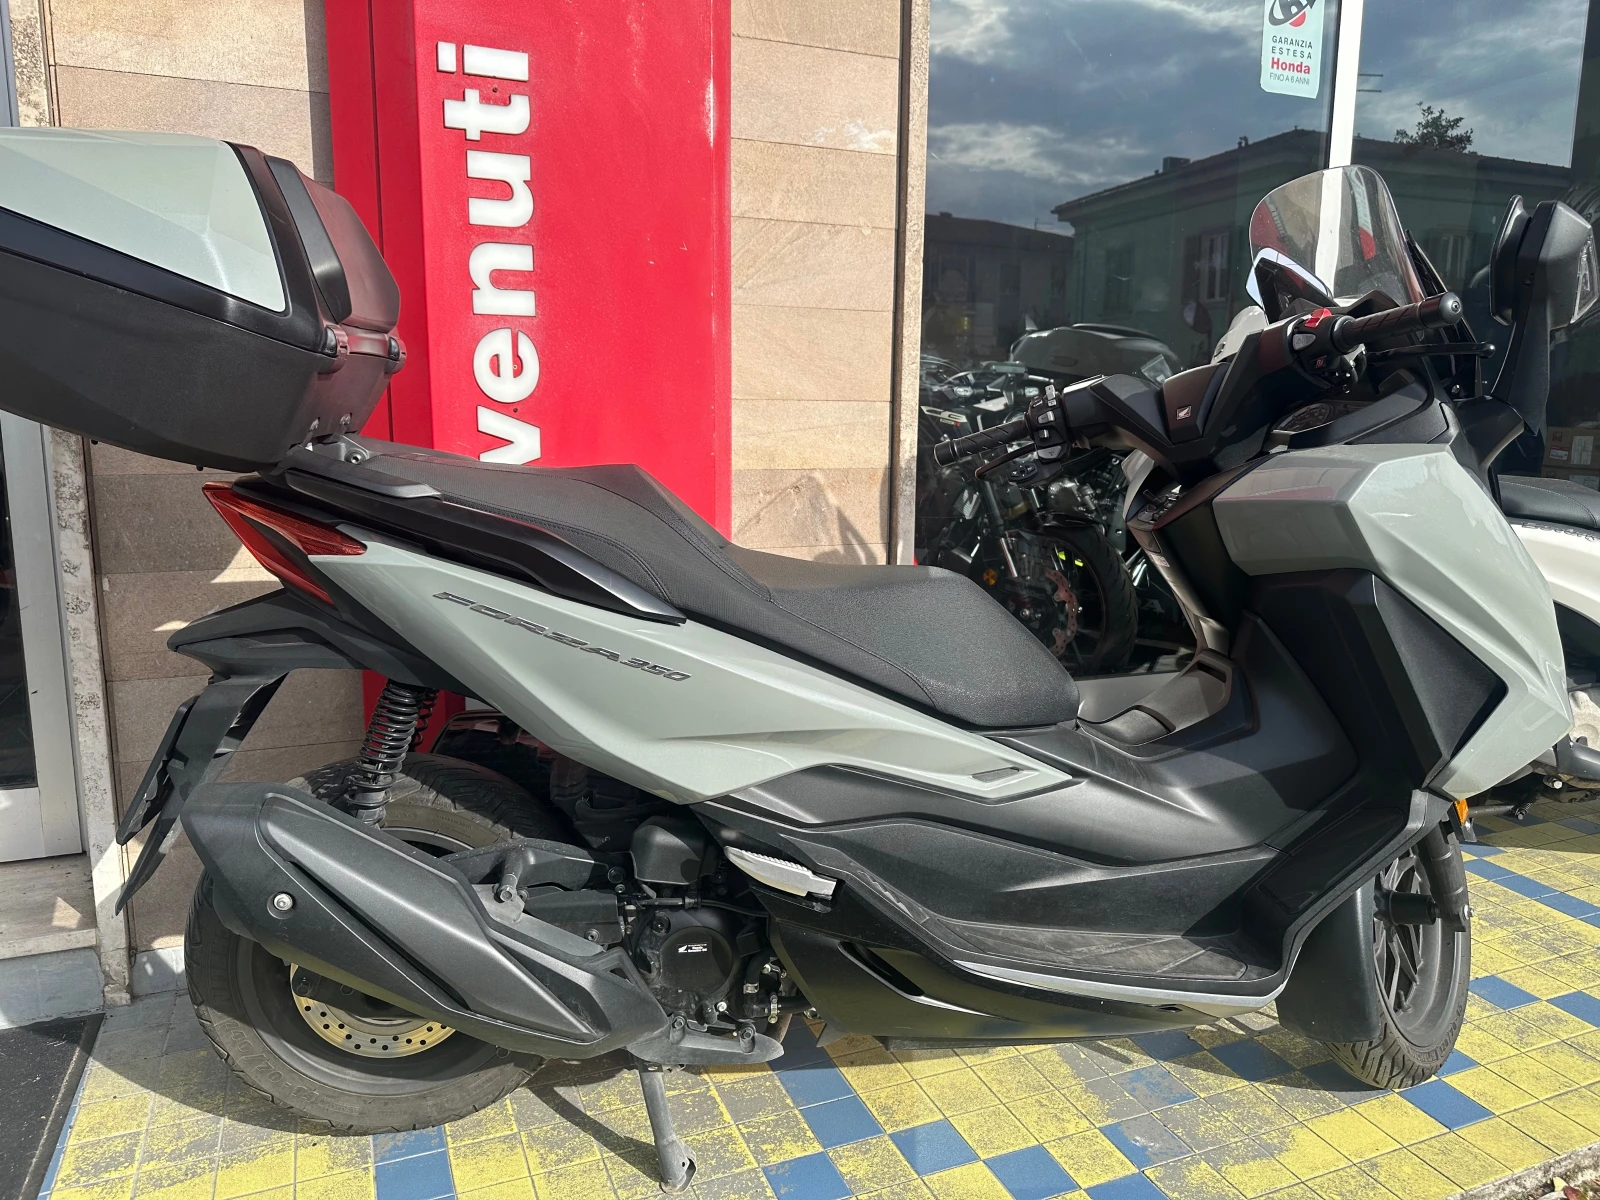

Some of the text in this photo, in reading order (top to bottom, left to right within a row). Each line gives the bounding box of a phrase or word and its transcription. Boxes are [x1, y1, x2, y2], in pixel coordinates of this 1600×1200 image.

[1272, 35, 1313, 49] GARANZIA
[1272, 46, 1312, 59] ESTESA
[1271, 57, 1311, 75] Honda
[1269, 72, 1284, 82] FINO
[1295, 76, 1310, 84] ANNI
[432, 591, 692, 682] FORZA 350
